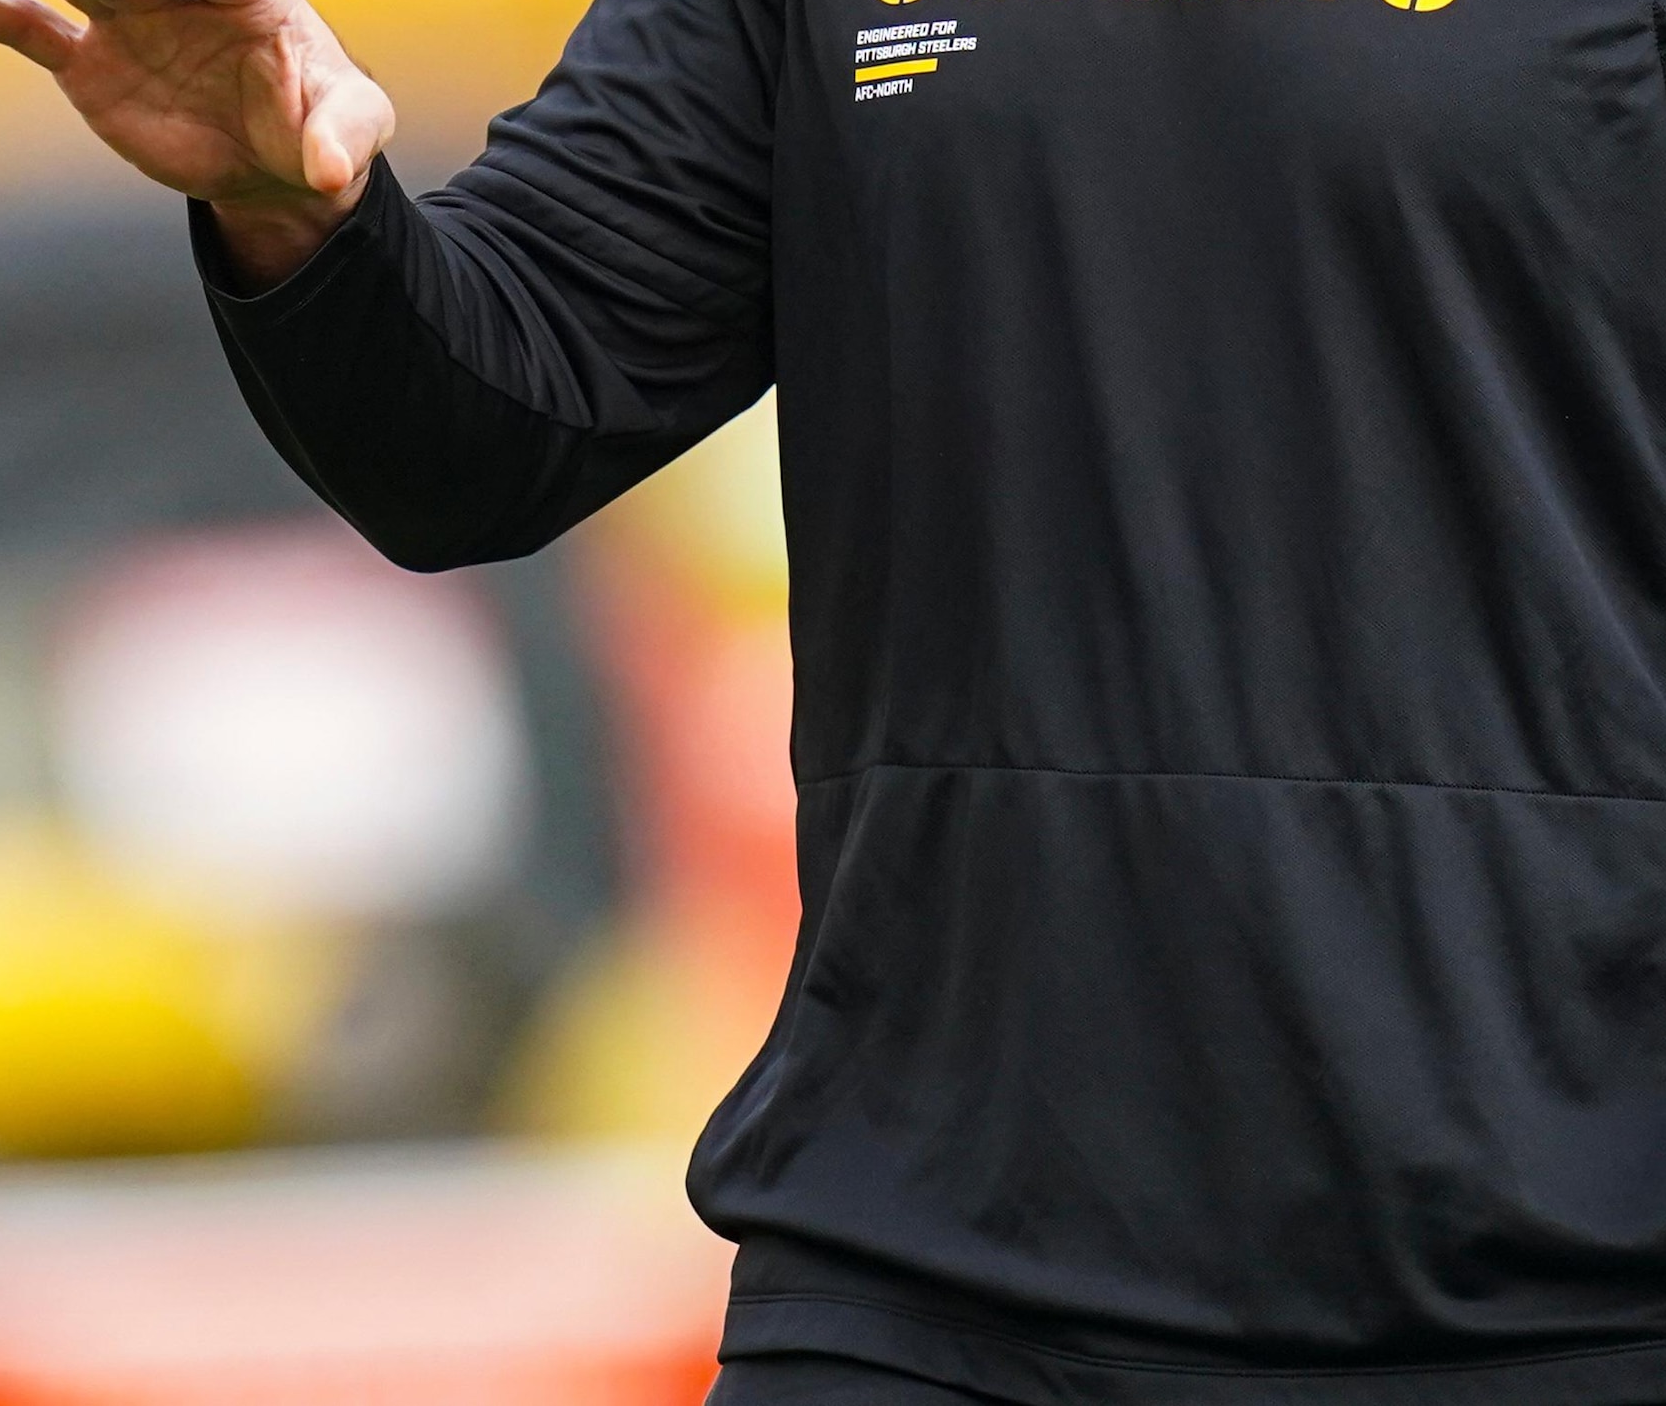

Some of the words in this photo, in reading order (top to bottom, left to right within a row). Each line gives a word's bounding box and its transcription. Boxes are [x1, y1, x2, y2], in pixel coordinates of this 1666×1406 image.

[856, 22, 930, 45] ENGINEERED
[930, 20, 957, 35] FOR
[855, 42, 917, 63] PITTSBURGH
[917, 37, 977, 55] STEELERS
[855, 78, 913, 102] AFC-NORTH
